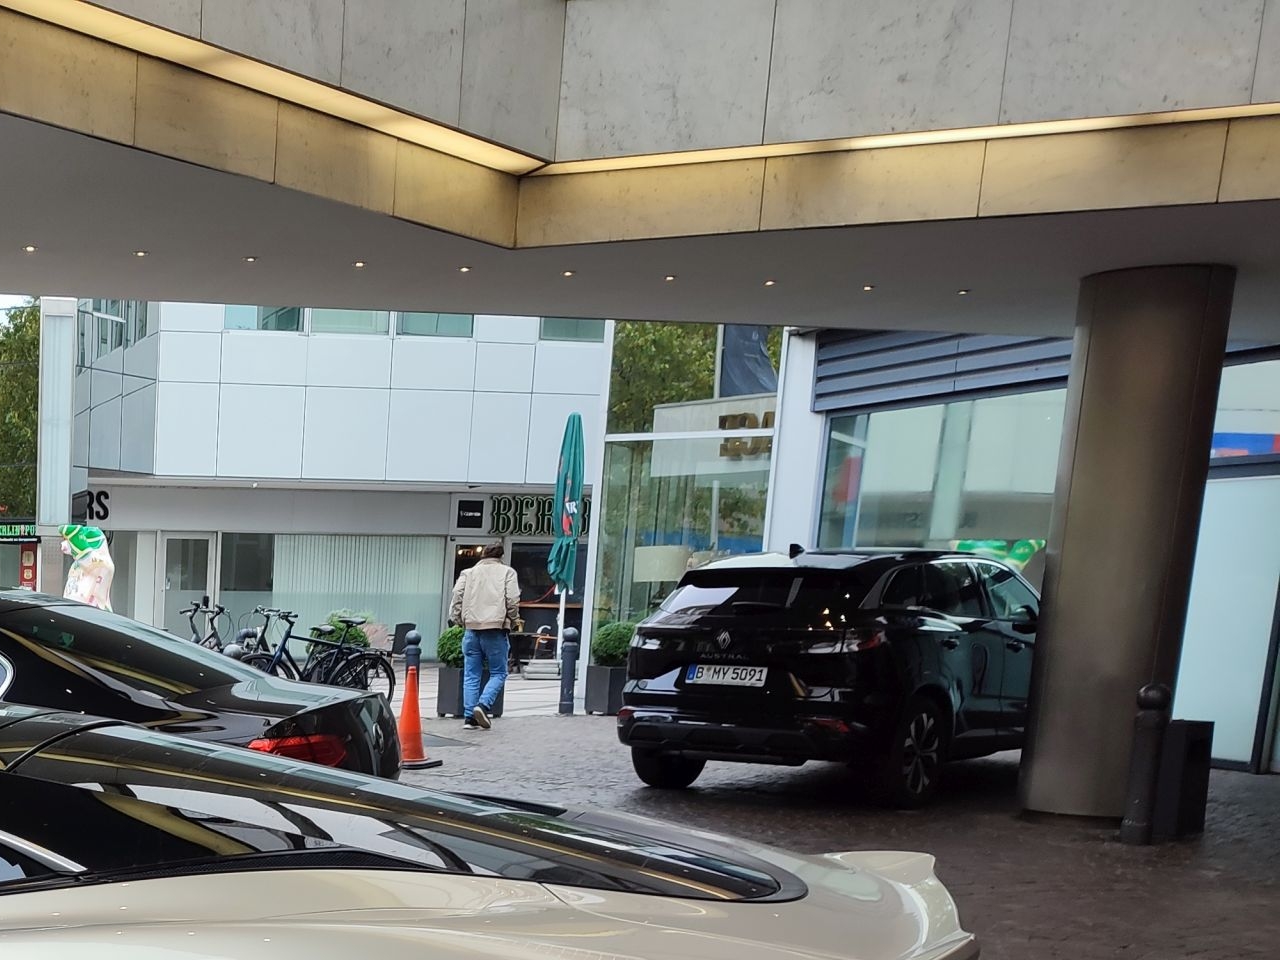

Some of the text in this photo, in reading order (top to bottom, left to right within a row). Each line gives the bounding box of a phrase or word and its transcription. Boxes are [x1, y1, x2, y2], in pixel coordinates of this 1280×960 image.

[25, 525, 37, 537] PU
[696, 667, 764, 682] B MY 5091
